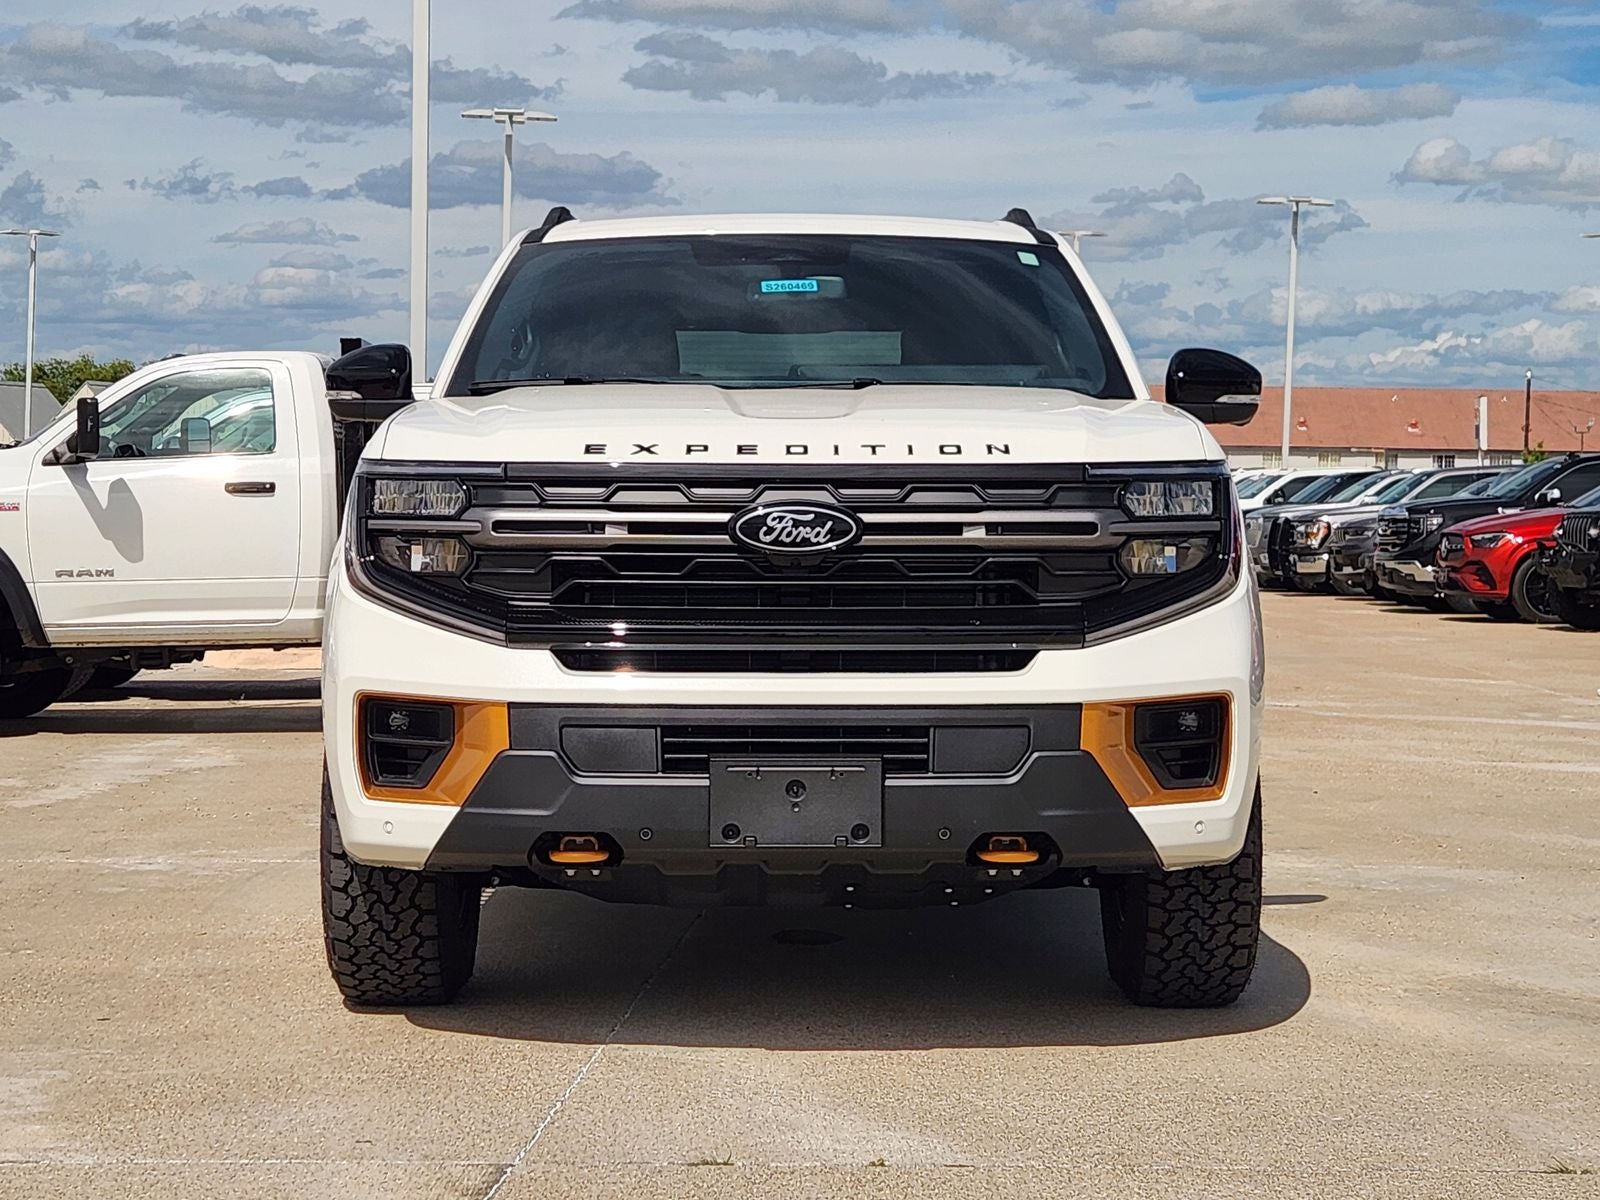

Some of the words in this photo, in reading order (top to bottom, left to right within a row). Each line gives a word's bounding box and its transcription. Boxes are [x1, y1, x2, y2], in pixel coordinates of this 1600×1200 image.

[765, 282, 815, 291] S260469
[583, 443, 1011, 456] EXPEDITION
[759, 512, 834, 543] Ford
[55, 568, 115, 578] RAM
